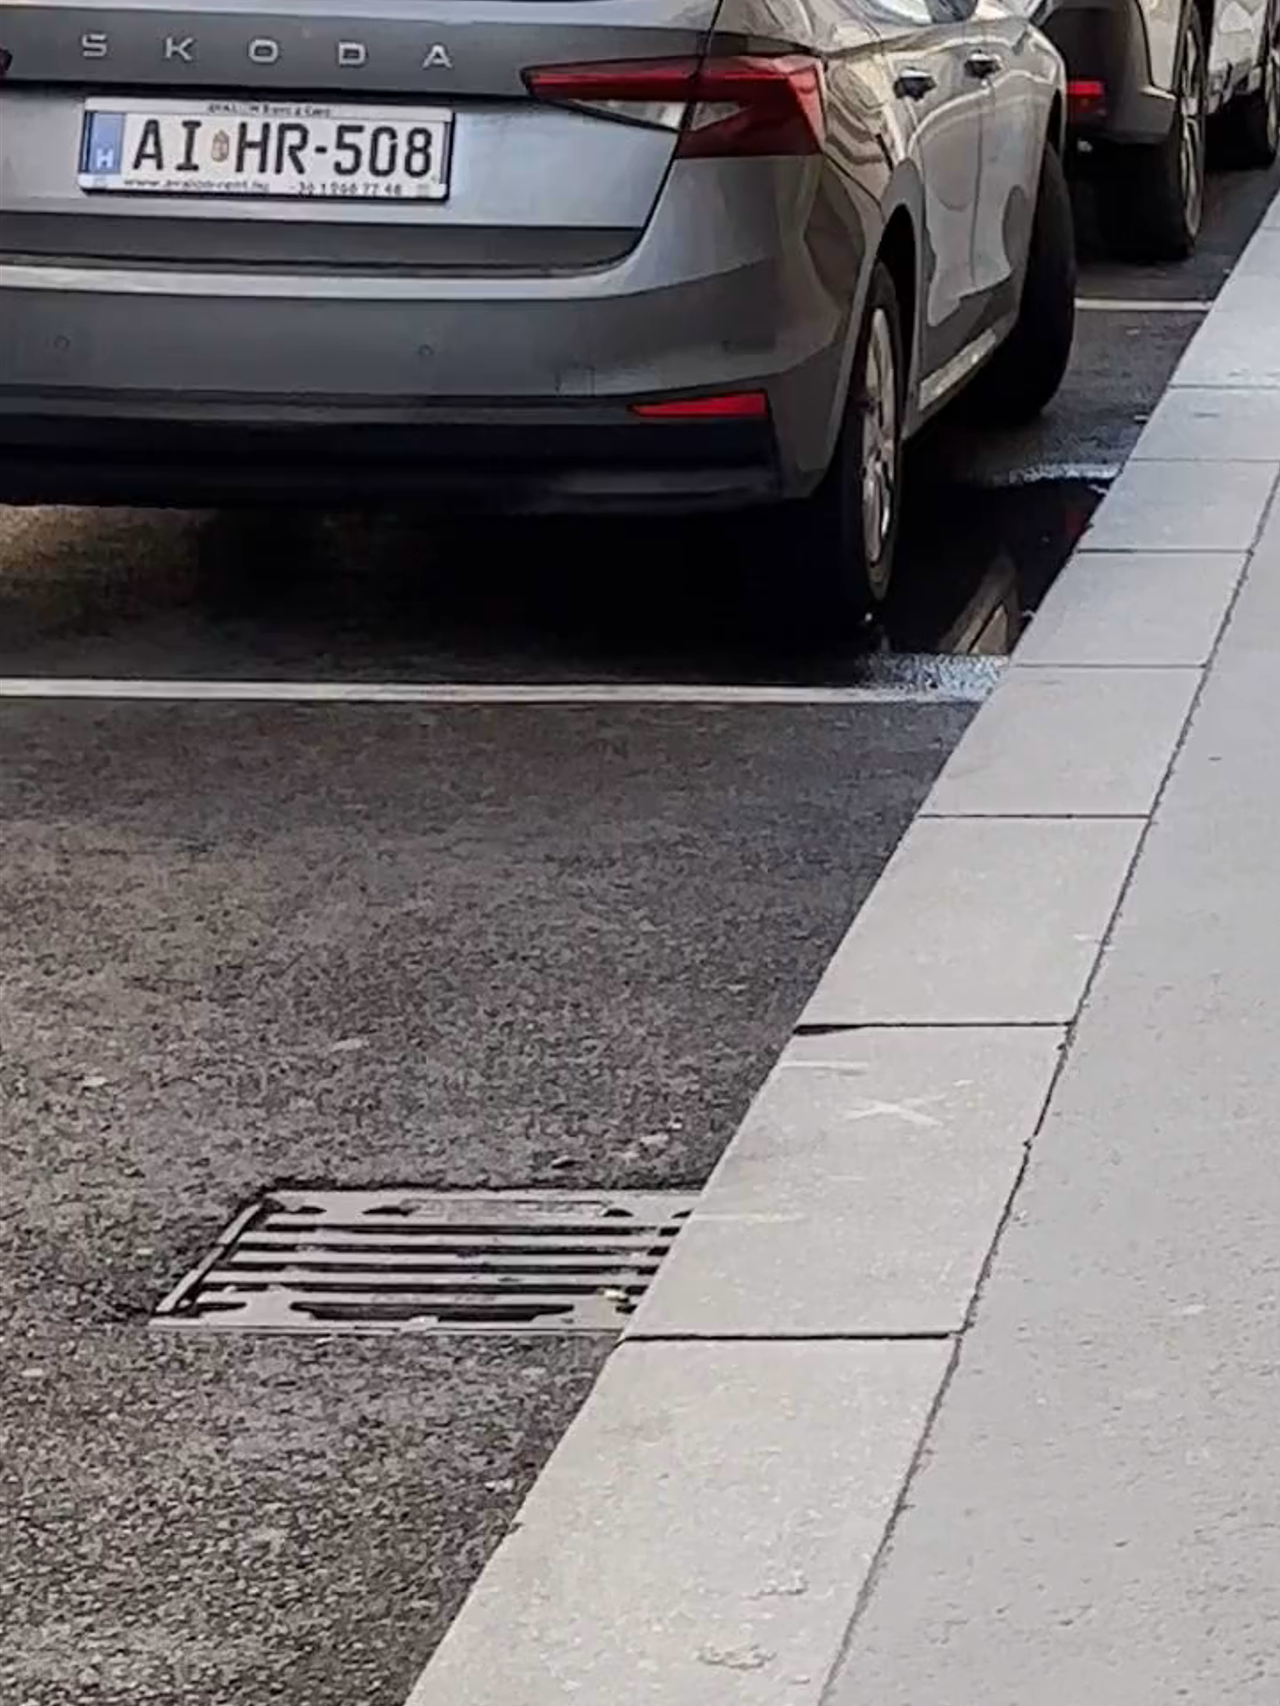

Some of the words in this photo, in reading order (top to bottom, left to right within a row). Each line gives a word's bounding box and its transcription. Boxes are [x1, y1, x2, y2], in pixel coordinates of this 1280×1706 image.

[82, 33, 452, 68] SKODA
[133, 119, 201, 172] AI
[234, 122, 434, 178] HR-508
